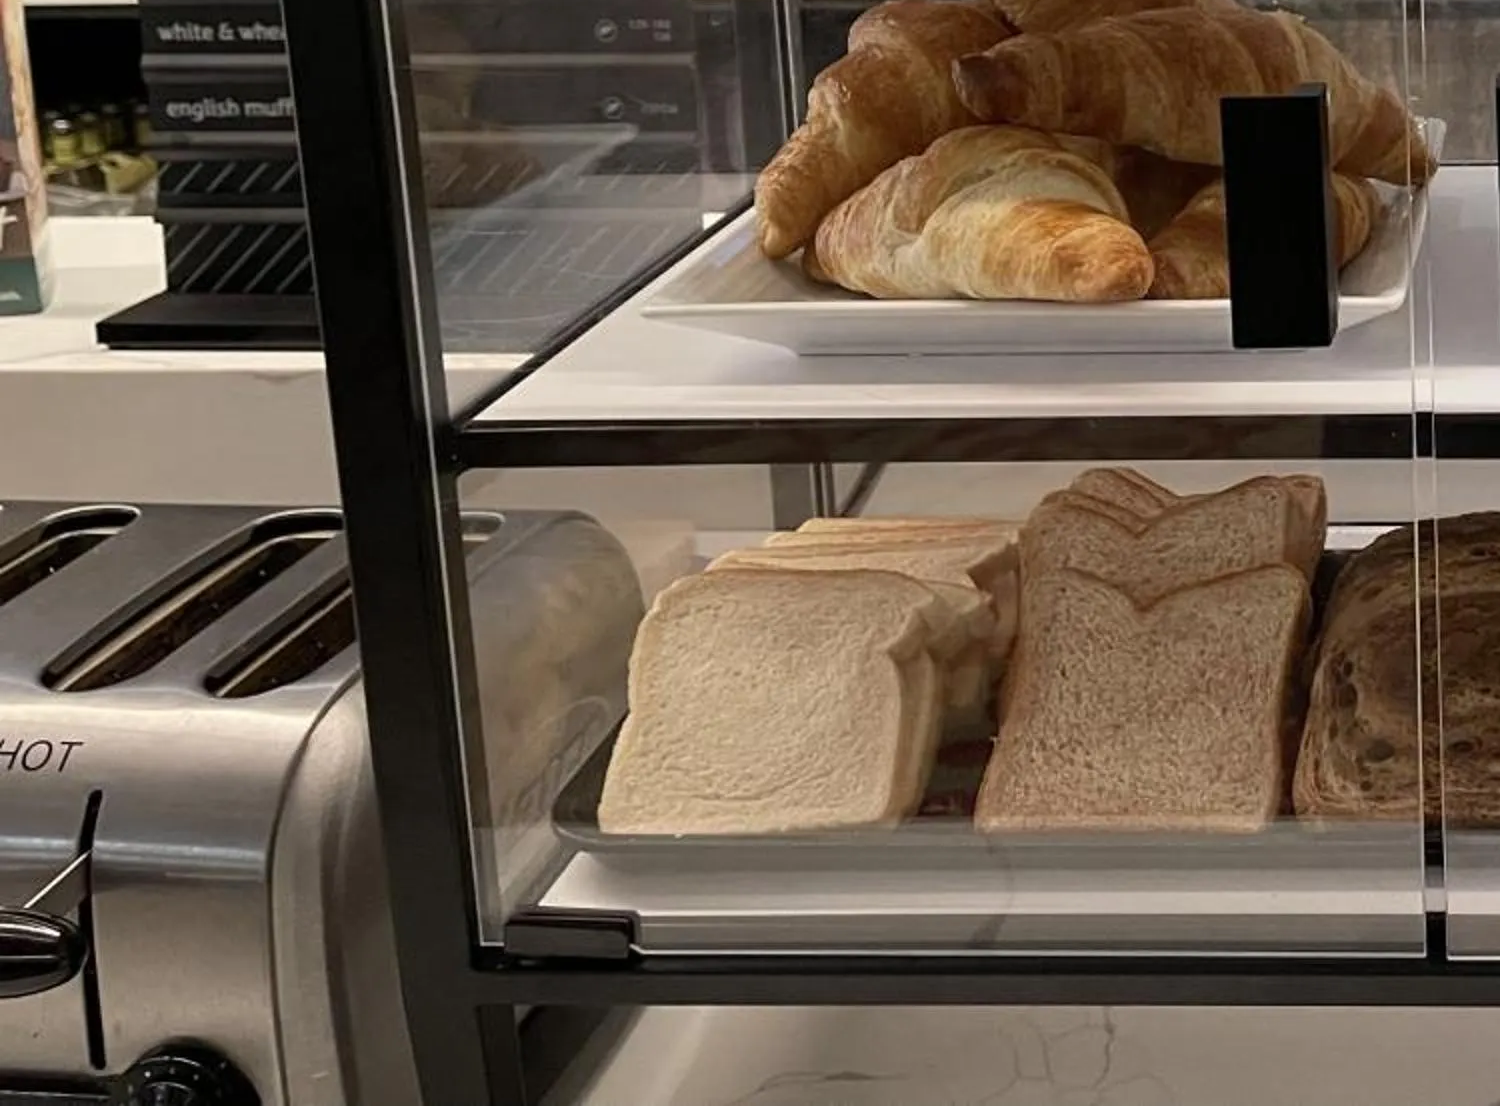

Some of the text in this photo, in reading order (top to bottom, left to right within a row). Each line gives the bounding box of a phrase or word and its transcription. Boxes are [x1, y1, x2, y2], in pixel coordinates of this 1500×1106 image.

[157, 22, 215, 42] white
[217, 22, 236, 42] &
[166, 96, 294, 123] english muff
[0, 739, 86, 773] HOT
